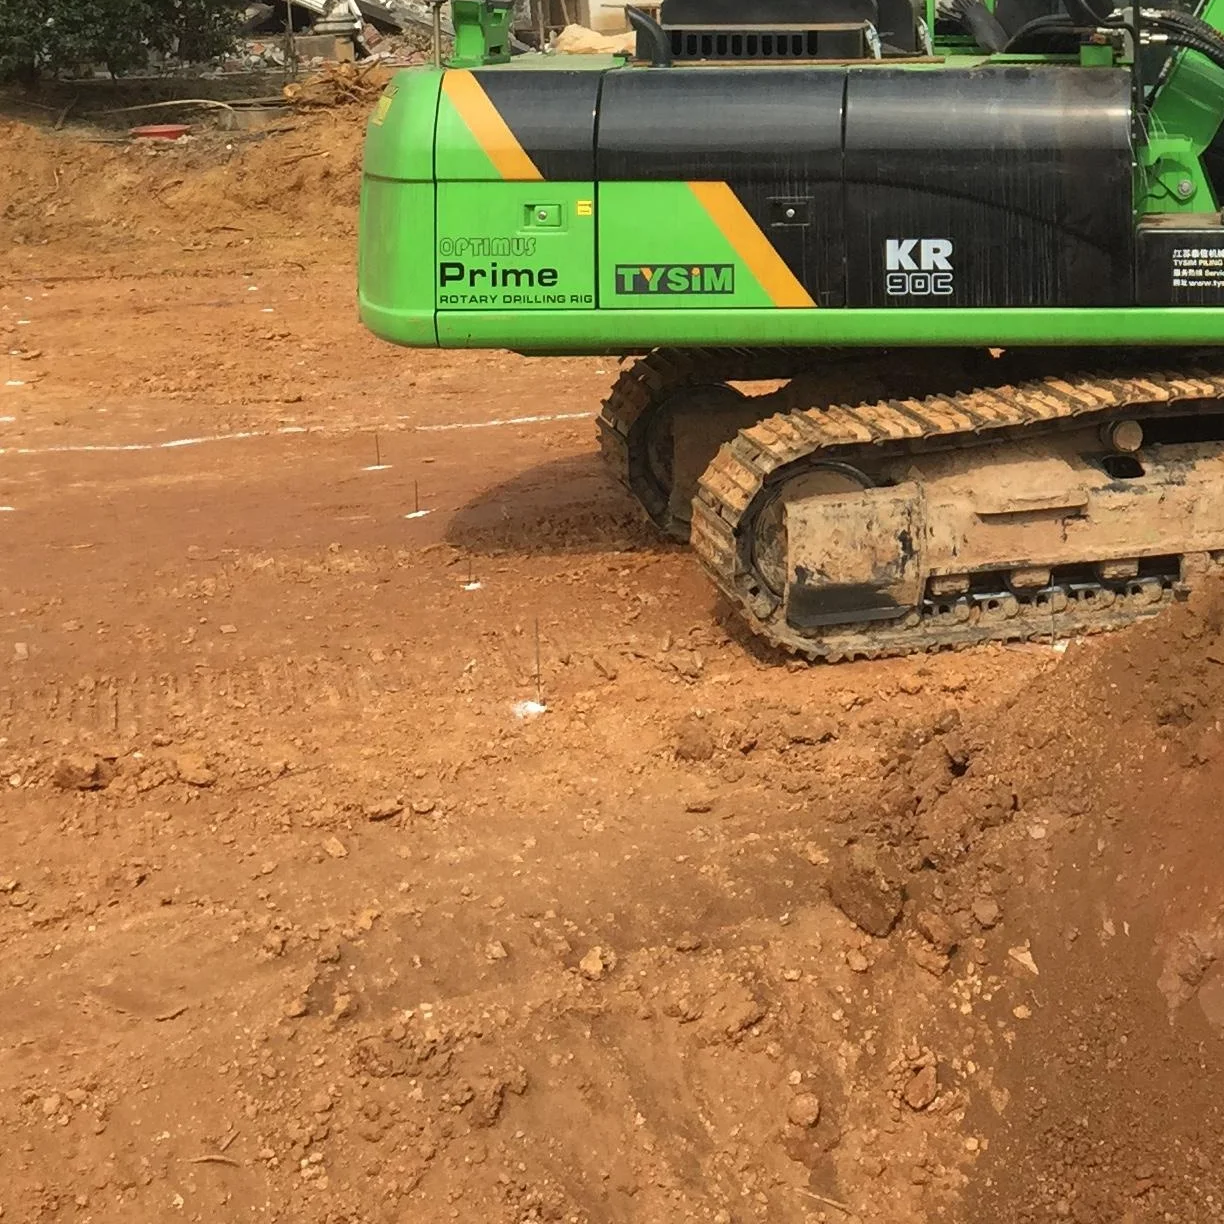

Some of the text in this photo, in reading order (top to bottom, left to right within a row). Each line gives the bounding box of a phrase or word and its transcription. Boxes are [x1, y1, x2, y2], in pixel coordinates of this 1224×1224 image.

[440, 237, 536, 256] OPTIMUS
[886, 239, 953, 270] KR
[440, 262, 558, 287] Prime
[886, 273, 953, 295] 90C
[440, 294, 593, 304] ROTARY DRILLING RIG
